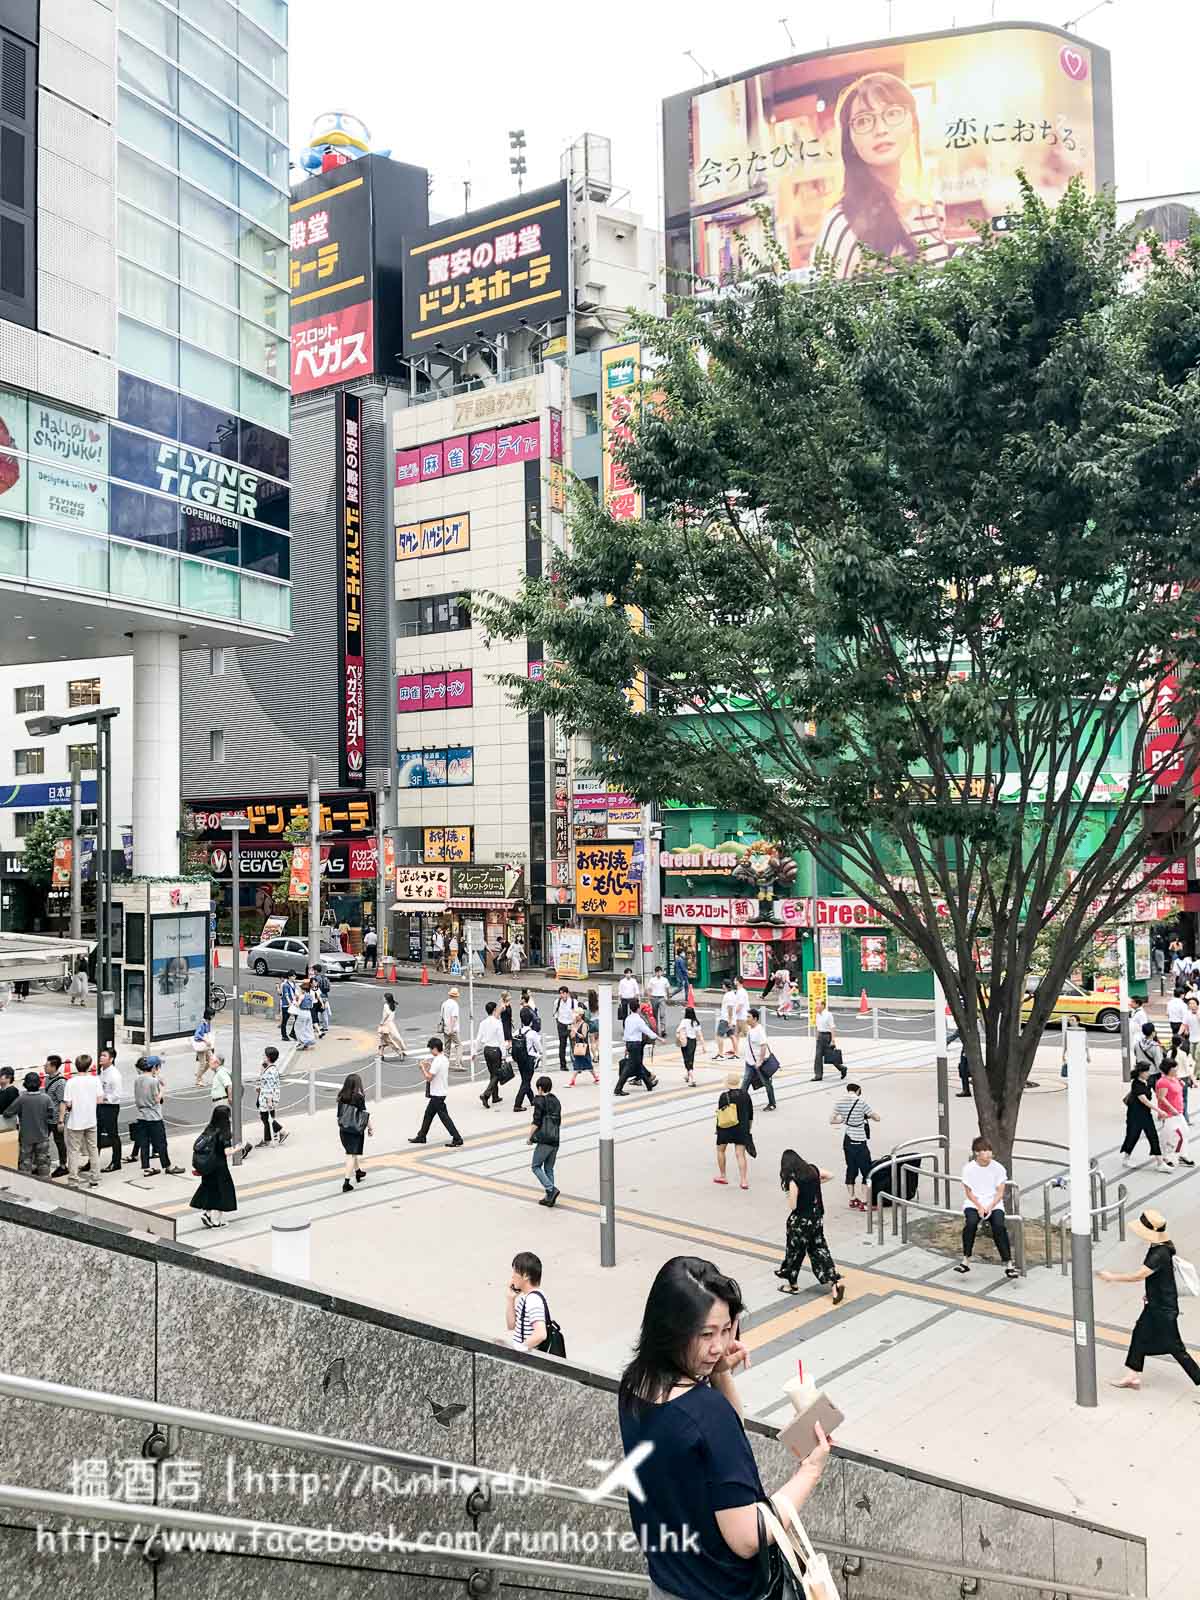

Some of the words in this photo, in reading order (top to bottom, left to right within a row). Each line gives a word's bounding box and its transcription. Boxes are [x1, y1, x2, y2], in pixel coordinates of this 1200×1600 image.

[945, 116, 1088, 158] 恋におちる。
[697, 138, 833, 188] 会うたびに、
[427, 223, 542, 287] 驚安の殿堂
[294, 331, 369, 379] ベガス
[33, 431, 103, 463] Shinjuku!
[158, 444, 259, 495] FLYING
[156, 466, 259, 520] TIGER
[180, 505, 239, 530] COPENHAGEN
[458, 872, 490, 883] クレープ
[659, 850, 700, 868] Green
[702, 851, 738, 868] Peas
[618, 900, 637, 914] 2F
[664, 903, 729, 918] 選べるスロット
